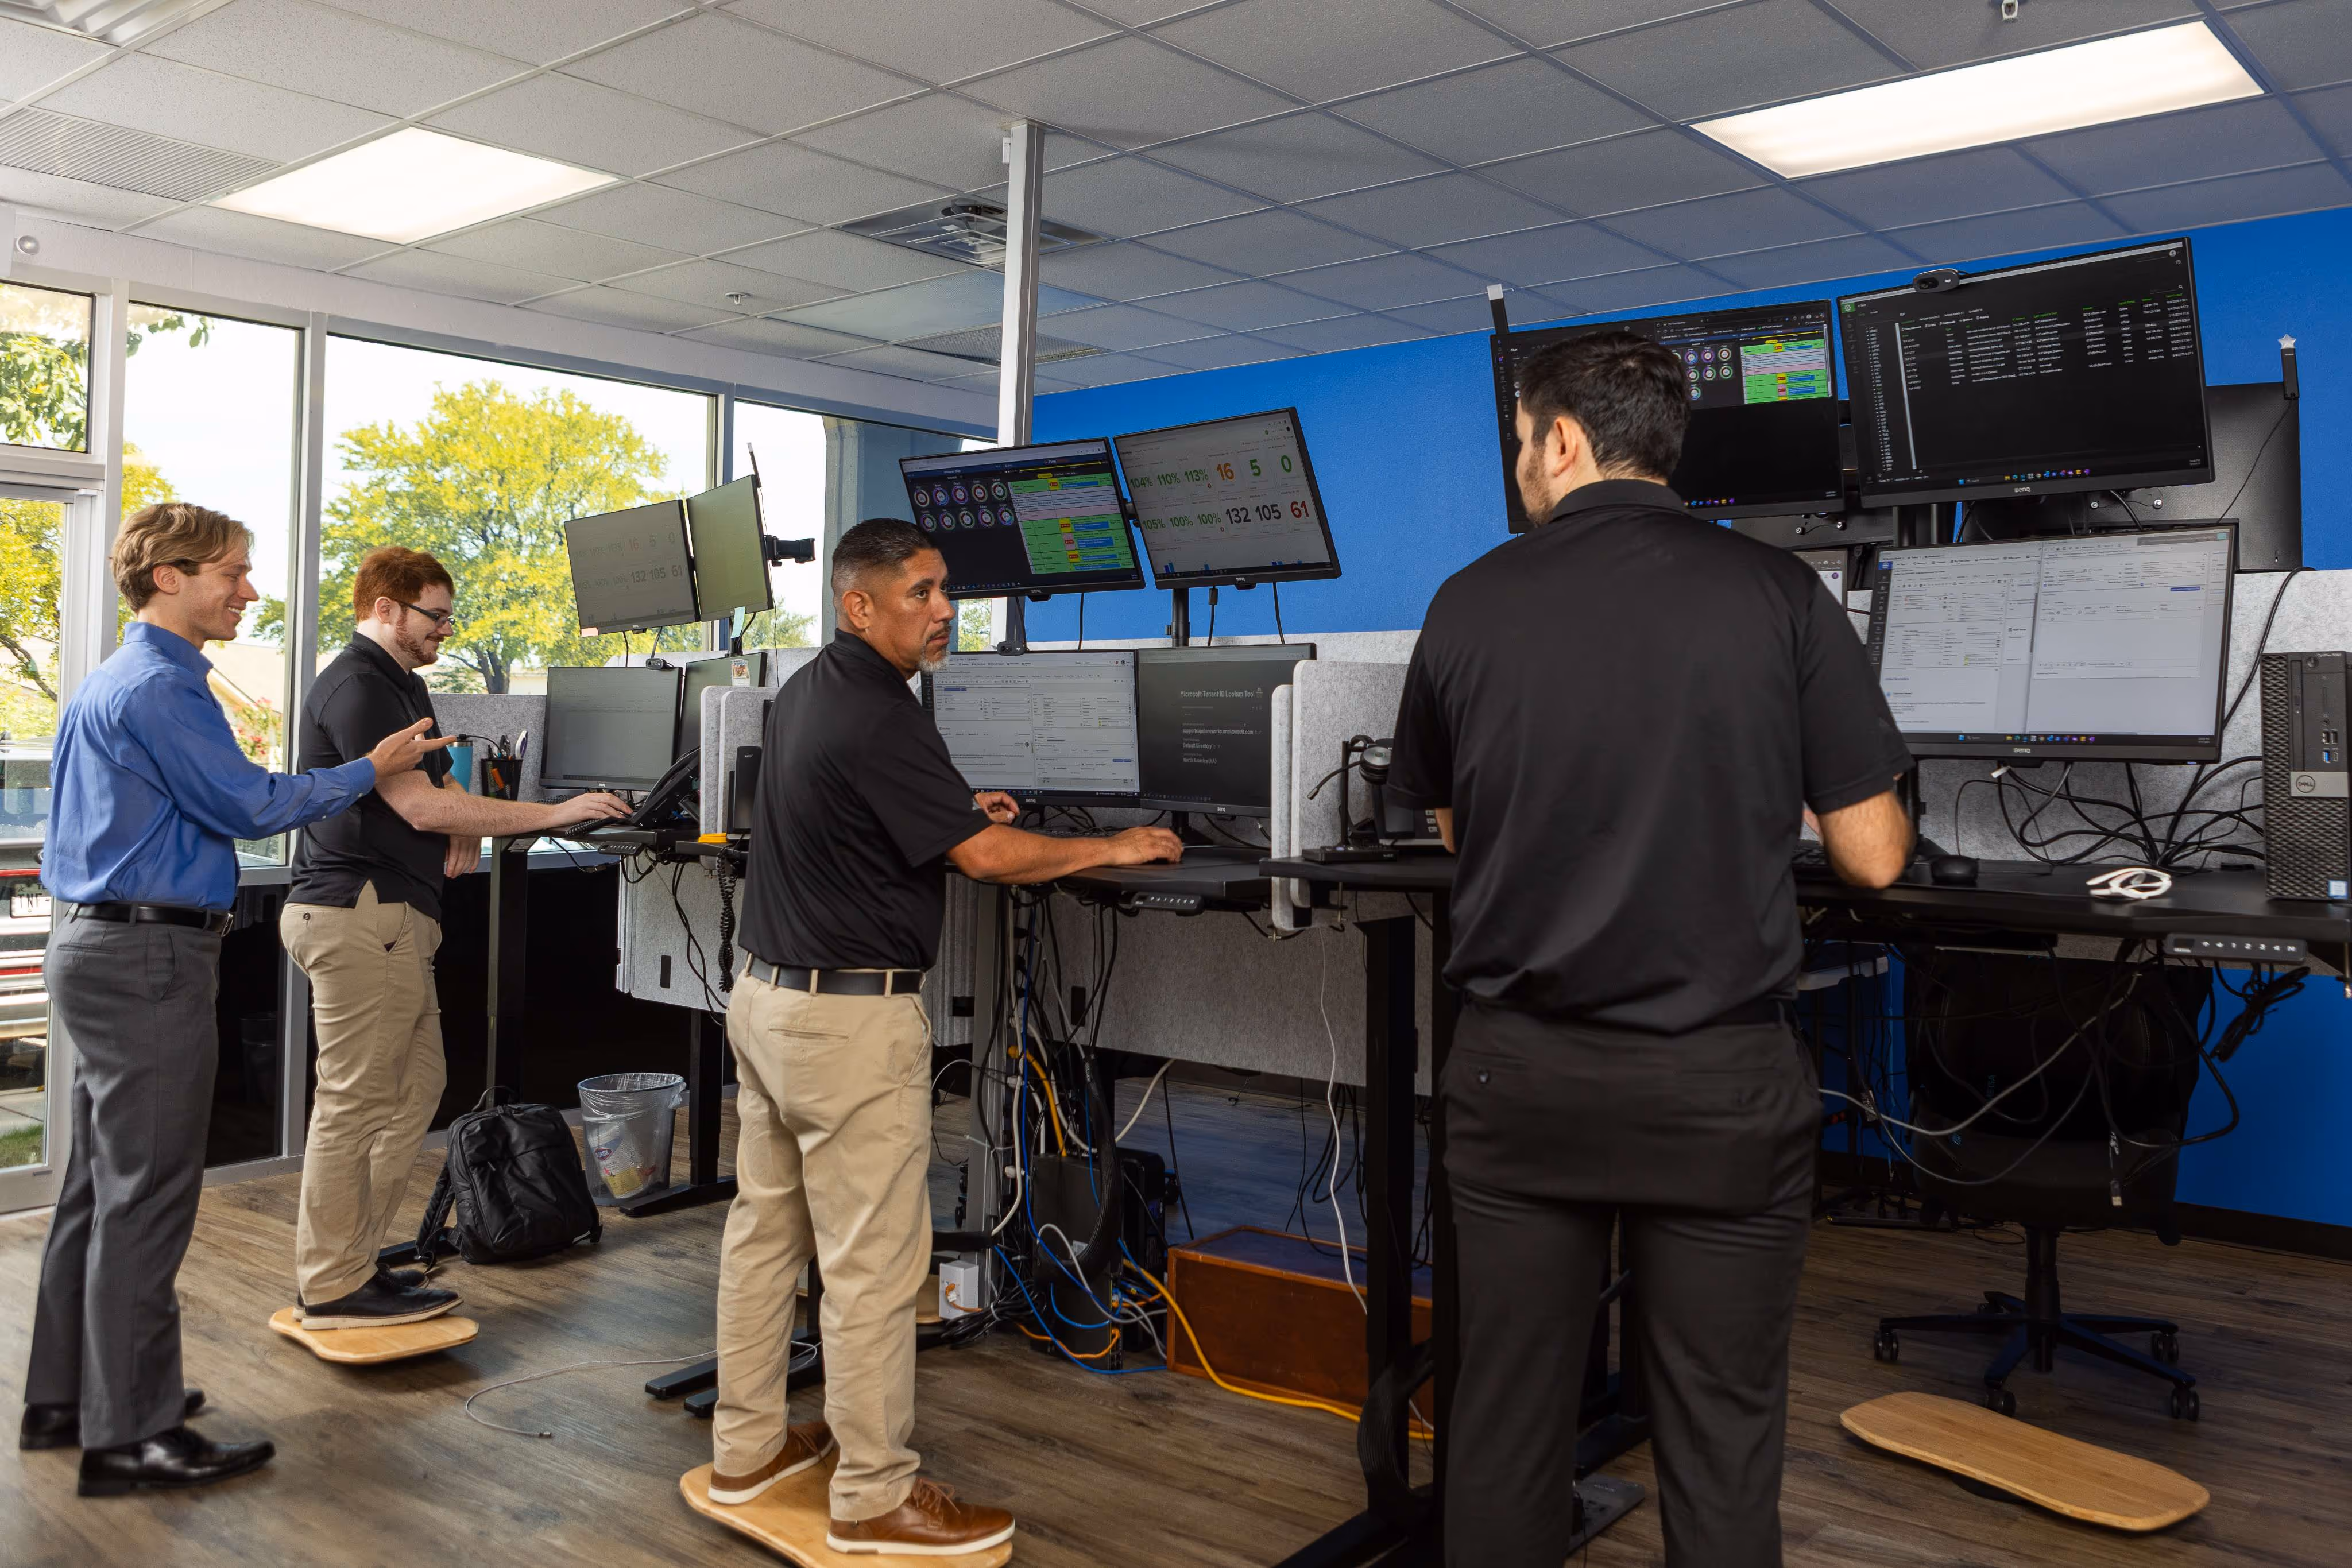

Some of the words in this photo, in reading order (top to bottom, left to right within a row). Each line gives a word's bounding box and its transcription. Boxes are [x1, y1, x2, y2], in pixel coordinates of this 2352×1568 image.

[1130, 476, 1154, 489] 104%
[1156, 472, 1181, 486] 110%
[1184, 469, 1209, 483] 113%
[1216, 462, 1235, 481] 16
[1250, 459, 1262, 477] 5
[1281, 455, 1292, 474] 0
[1142, 518, 1166, 531] 105%
[1169, 515, 1193, 528] 100%
[1197, 512, 1222, 525] 100%
[1225, 506, 1252, 525] 132
[1255, 503, 1282, 521] 105
[1290, 500, 1310, 519] 61
[629, 537, 639, 552] 16
[649, 535, 656, 548] 5
[630, 570, 647, 584] 132
[649, 567, 666, 580] 105
[671, 565, 683, 578] 61
[1180, 690, 1202, 698] Microsoft
[1225, 691, 1244, 699] Lookup
